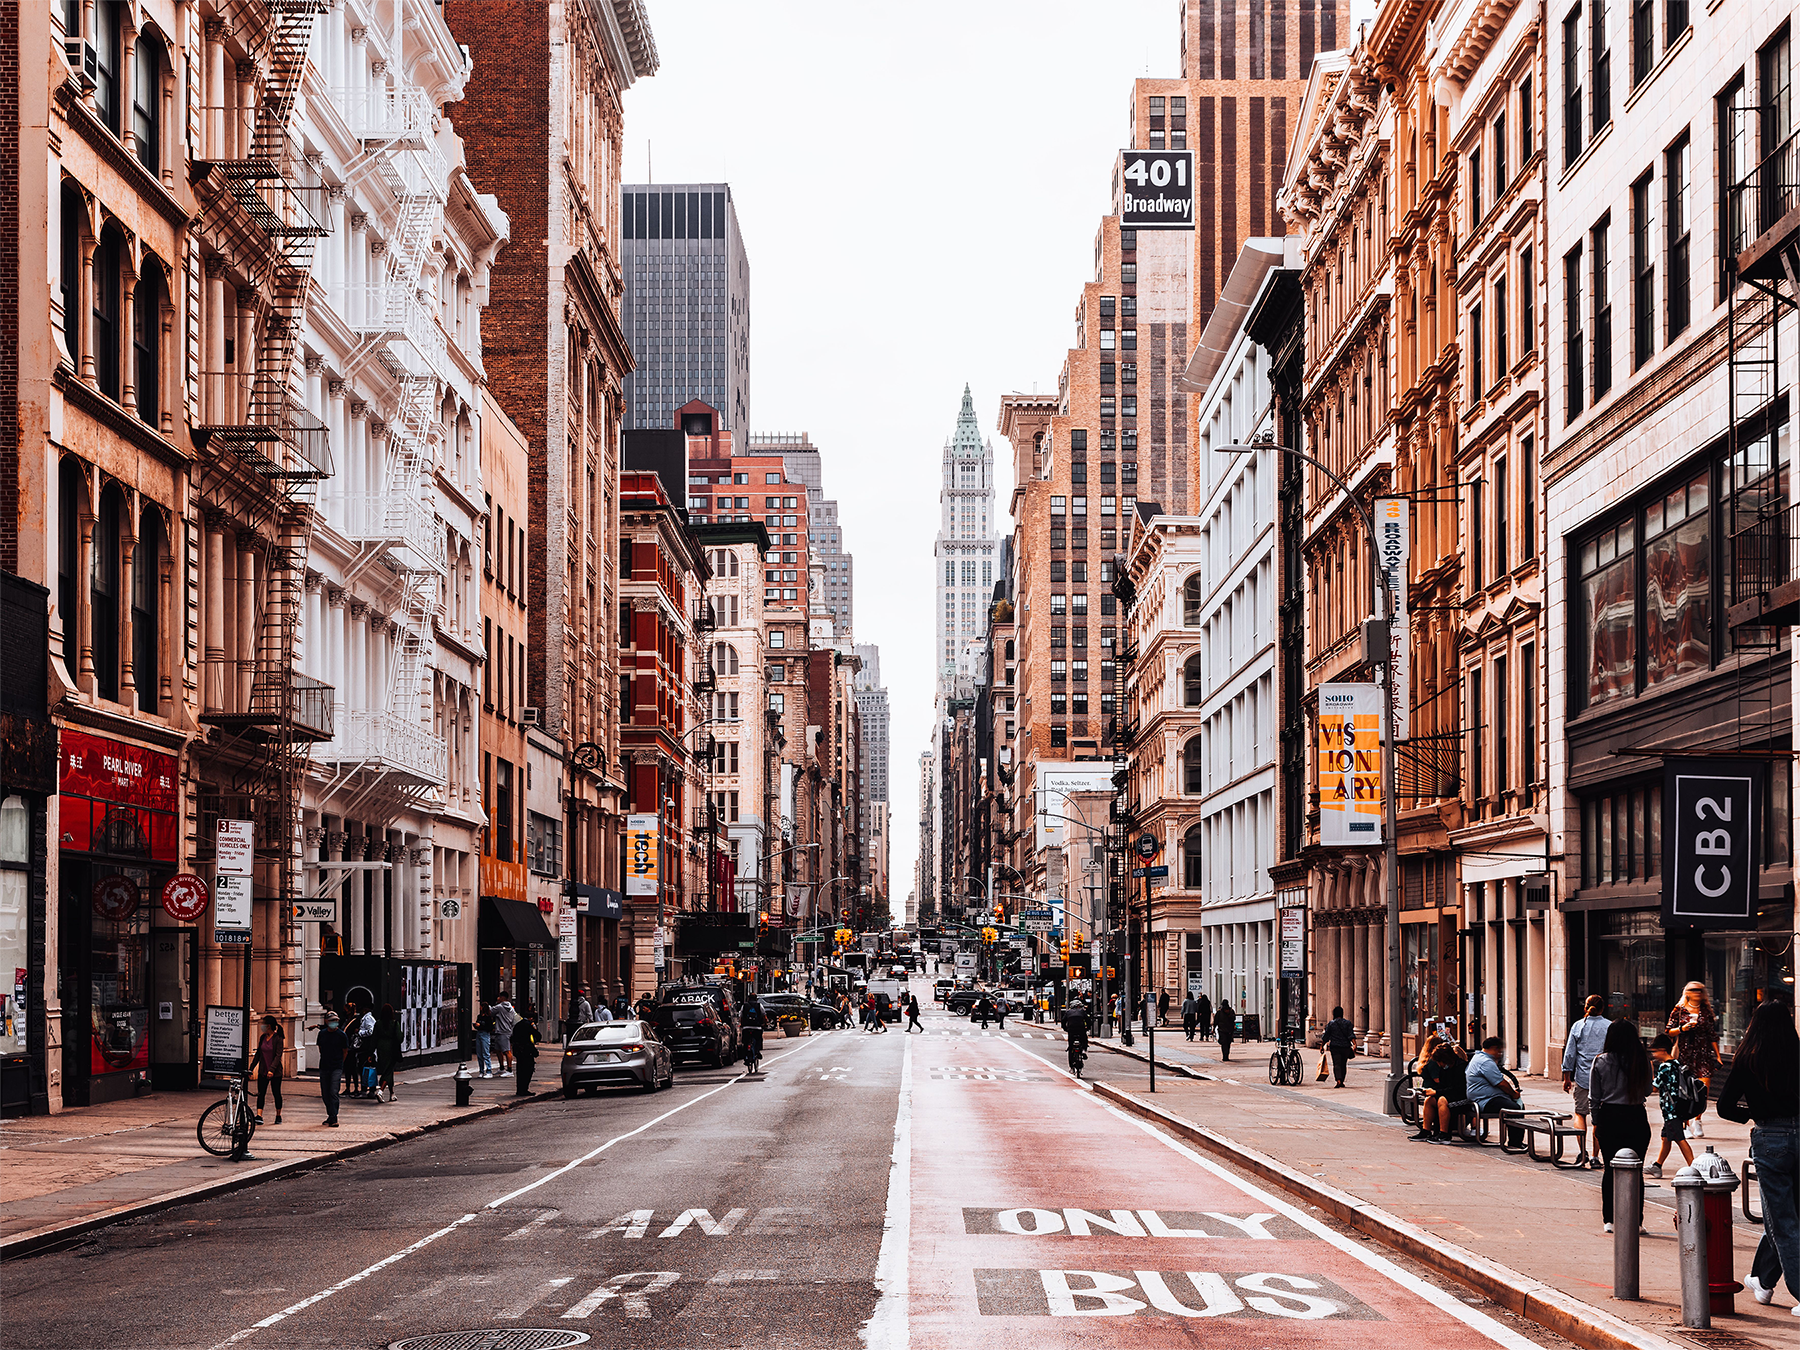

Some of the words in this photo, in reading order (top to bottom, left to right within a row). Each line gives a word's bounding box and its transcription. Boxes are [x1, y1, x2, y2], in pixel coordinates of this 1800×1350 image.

[1124, 159, 1186, 187] 401
[1124, 193, 1191, 218] Broadway
[103, 755, 123, 773] PEARL
[125, 761, 142, 777] RIVER
[118, 777, 128, 787] MART
[221, 822, 227, 832] 3
[634, 833, 654, 874] tech
[1694, 797, 1731, 897] CB2
[165, 880, 179, 894] PEARL
[195, 880, 206, 894] MART
[220, 877, 225, 887] 2
[307, 906, 332, 917] Valley
[215, 1010, 239, 1018] better
[998, 1208, 1278, 1240] ONLY
[1040, 1270, 1340, 1319] BUS
